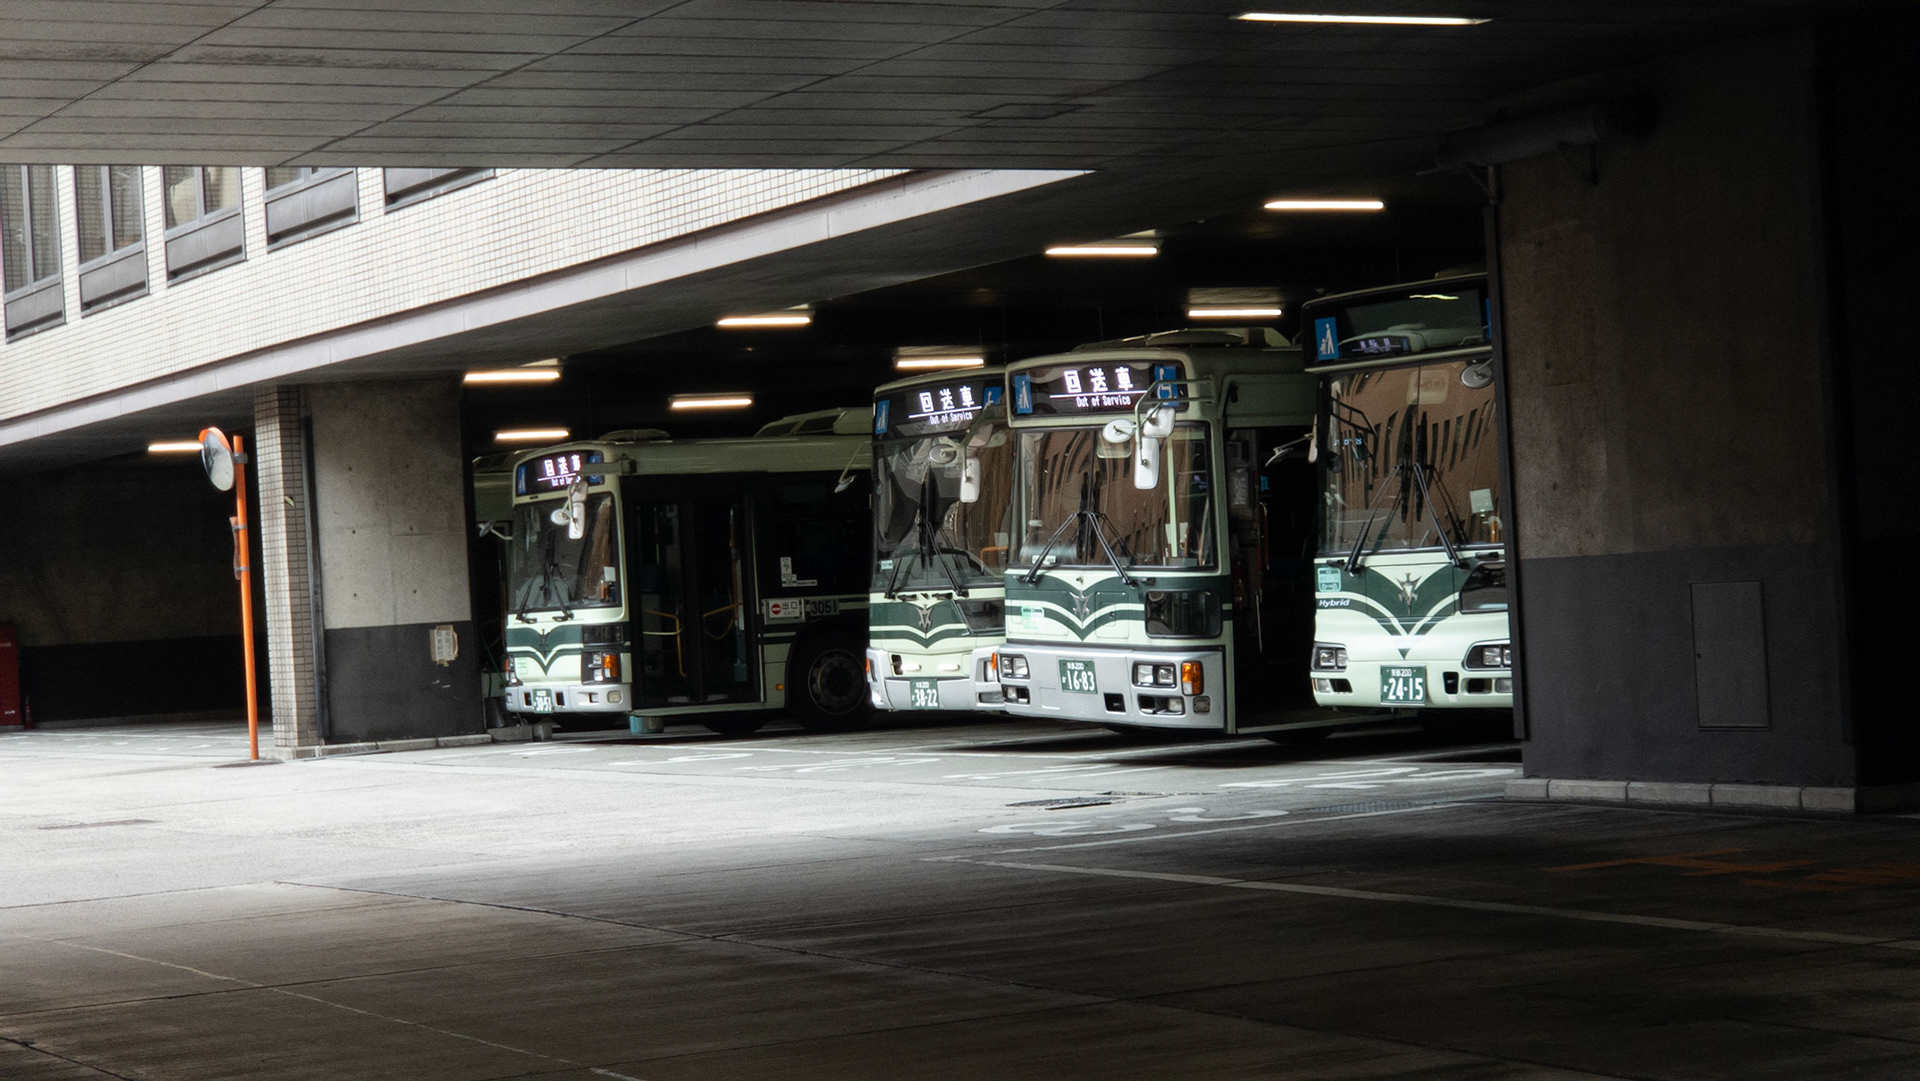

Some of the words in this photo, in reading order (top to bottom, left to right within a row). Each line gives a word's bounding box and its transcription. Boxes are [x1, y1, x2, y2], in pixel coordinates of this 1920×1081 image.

[1063, 366, 1134, 394] 回送車
[919, 385, 975, 413] 回送車
[1076, 396, 1089, 407] Out
[1091, 396, 1100, 407] of
[1102, 394, 1131, 406] Service
[929, 415, 940, 425] Out
[941, 413, 948, 423] of
[950, 411, 973, 422] Service
[782, 601, 798, 610] 出口
[810, 600, 838, 614] 3051
[1319, 599, 1351, 608] Hybrid
